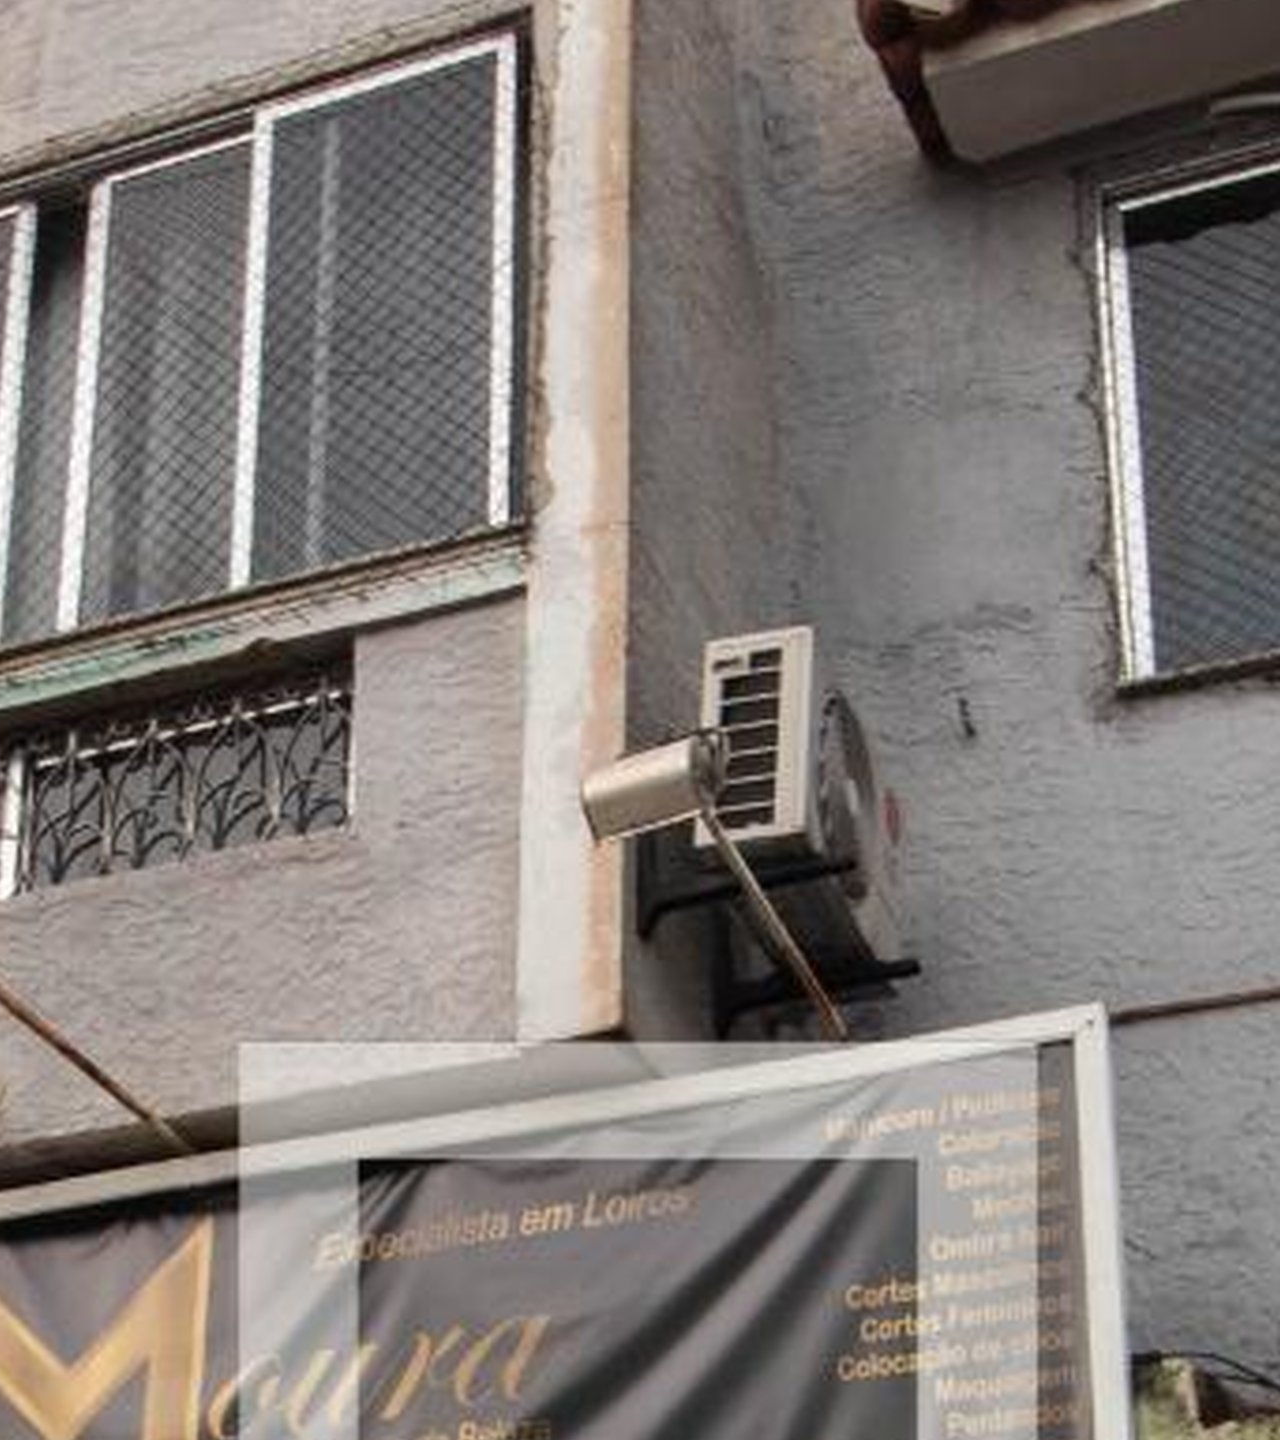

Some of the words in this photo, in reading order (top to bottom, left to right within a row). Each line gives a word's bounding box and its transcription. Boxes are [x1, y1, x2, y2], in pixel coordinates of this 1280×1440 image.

[520, 1200, 574, 1236] em
[845, 1272, 925, 1310] Cortes
[859, 1314, 942, 1343] Cortes
